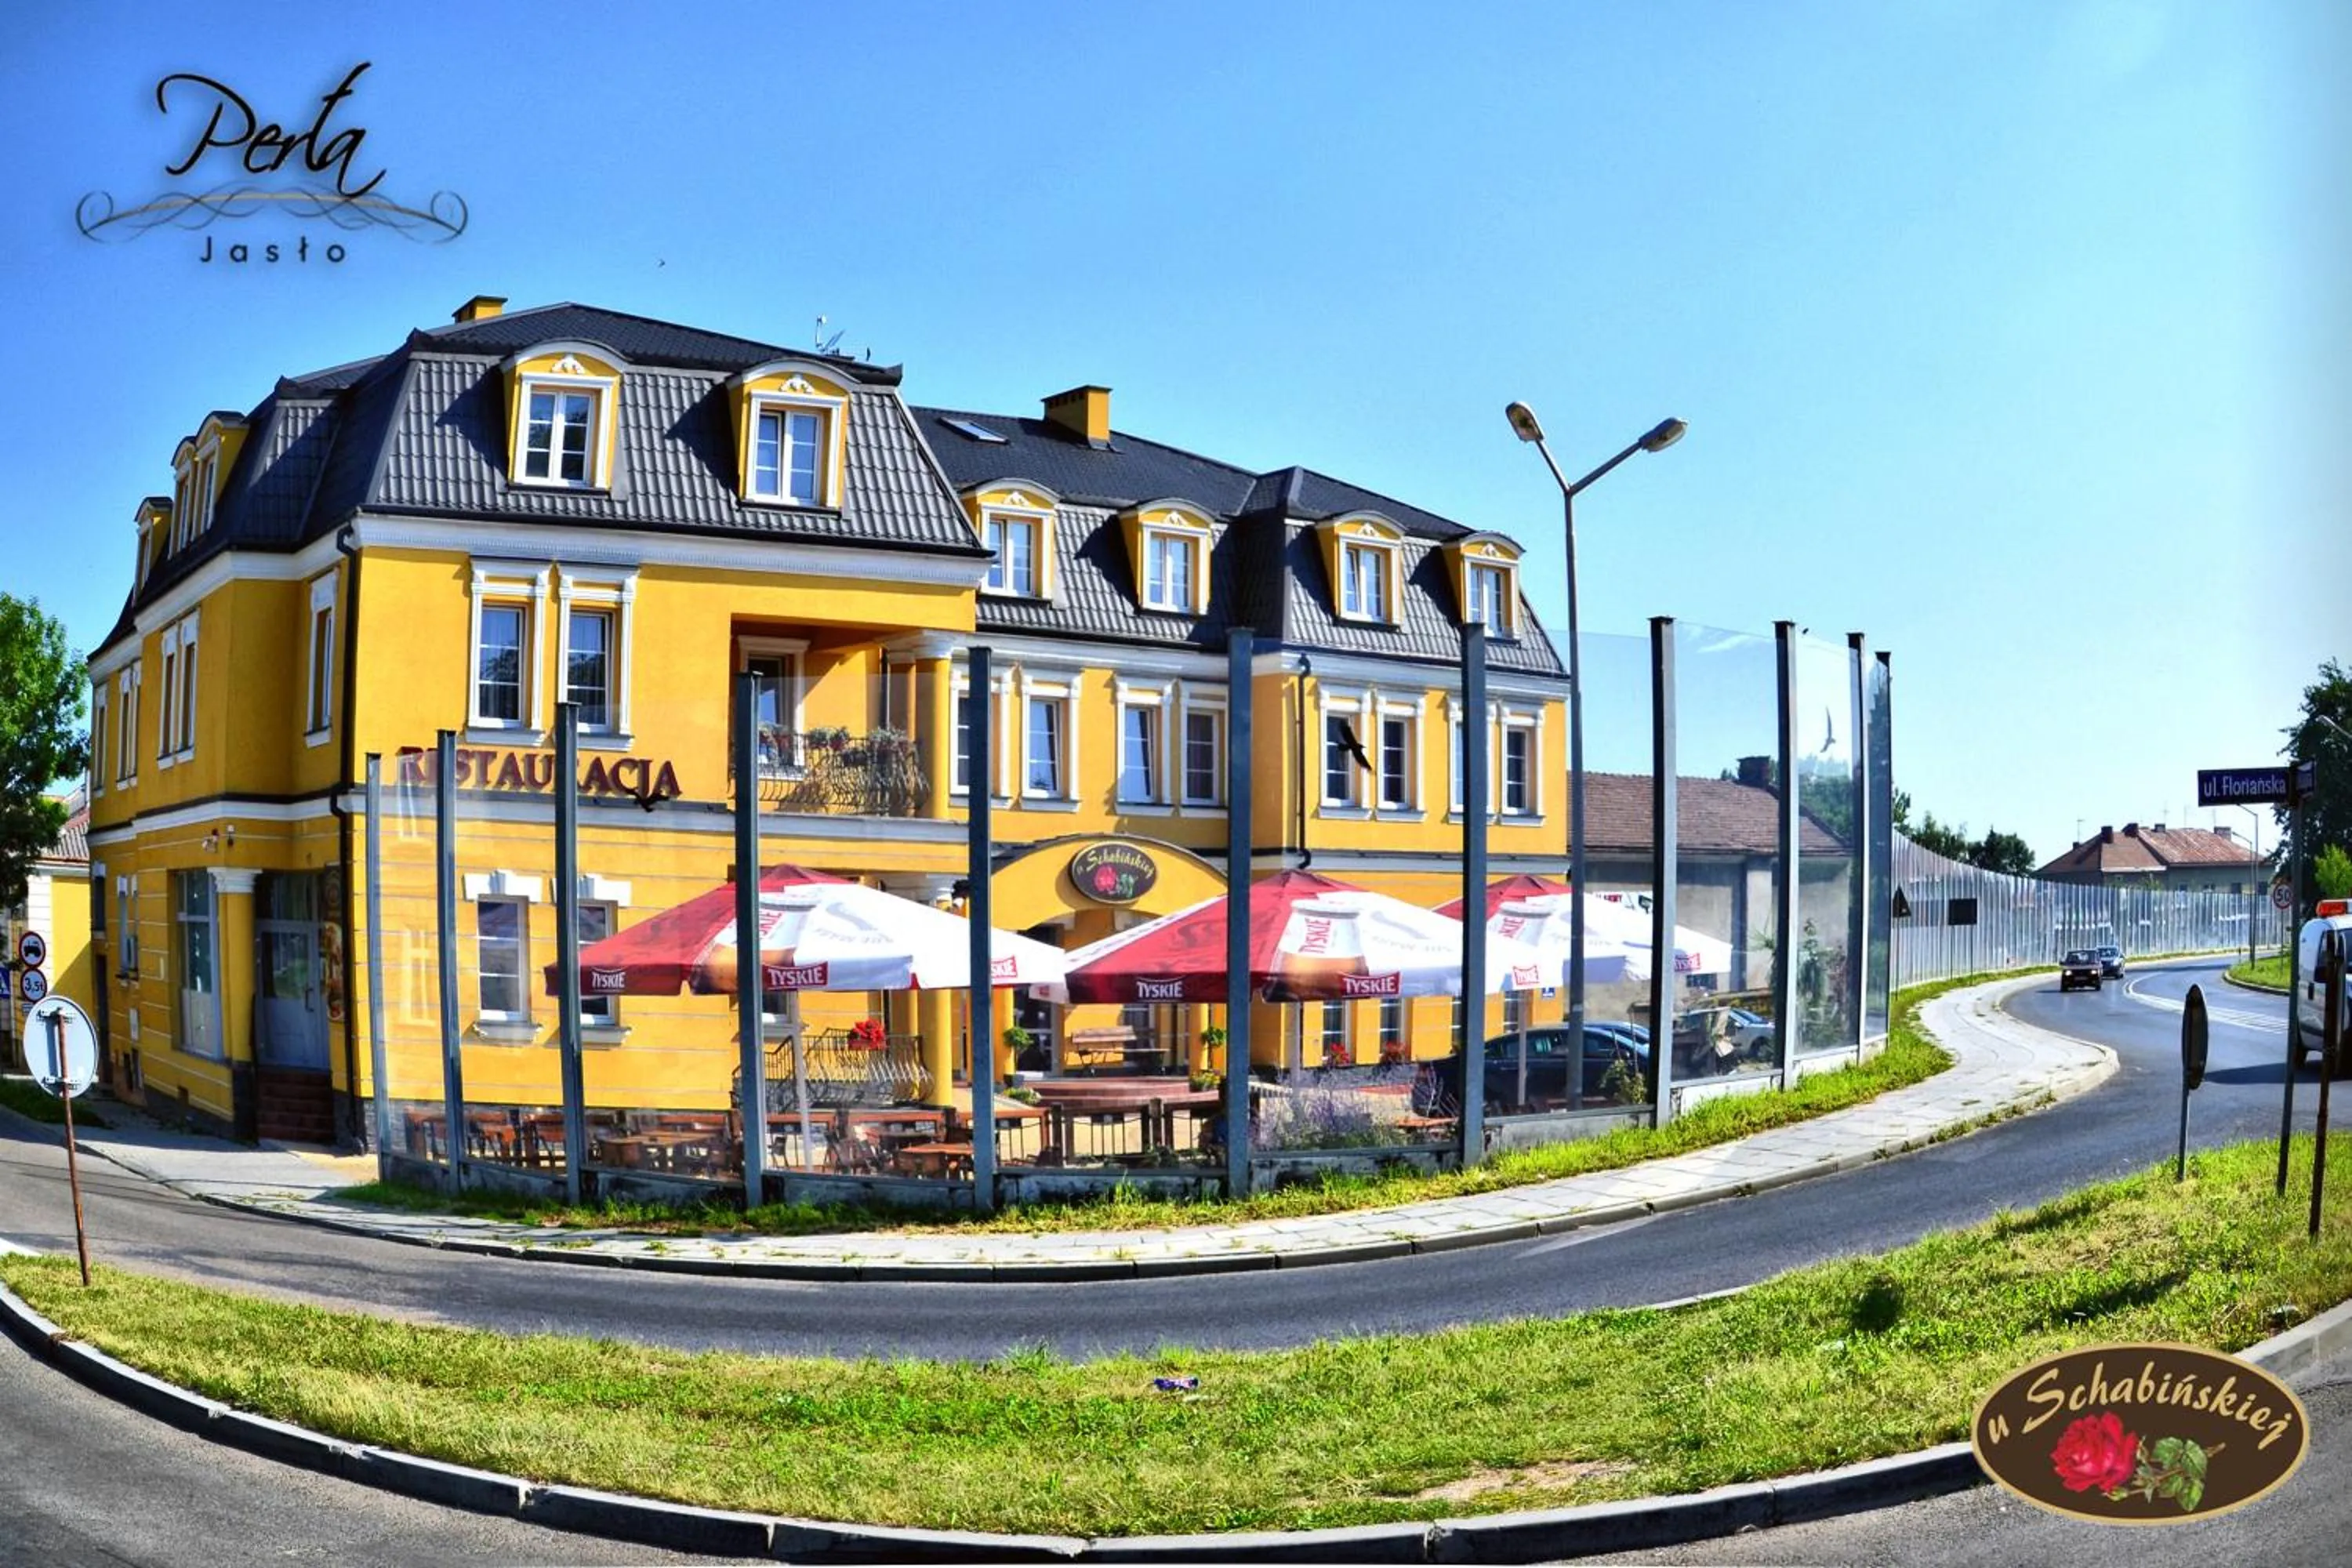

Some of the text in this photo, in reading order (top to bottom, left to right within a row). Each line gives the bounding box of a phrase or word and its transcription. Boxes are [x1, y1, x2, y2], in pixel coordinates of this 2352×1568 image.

[394, 746, 682, 798] RSTAUACJA
[2204, 776, 2221, 797] ul.
[2222, 775, 2287, 796] Floriańska
[2277, 888, 2292, 900] 50
[591, 971, 626, 988] TYSKIE
[768, 967, 824, 985] TYSKIE
[1343, 976, 1396, 993] TYSKIE
[1136, 981, 1182, 997] TYSKIE
